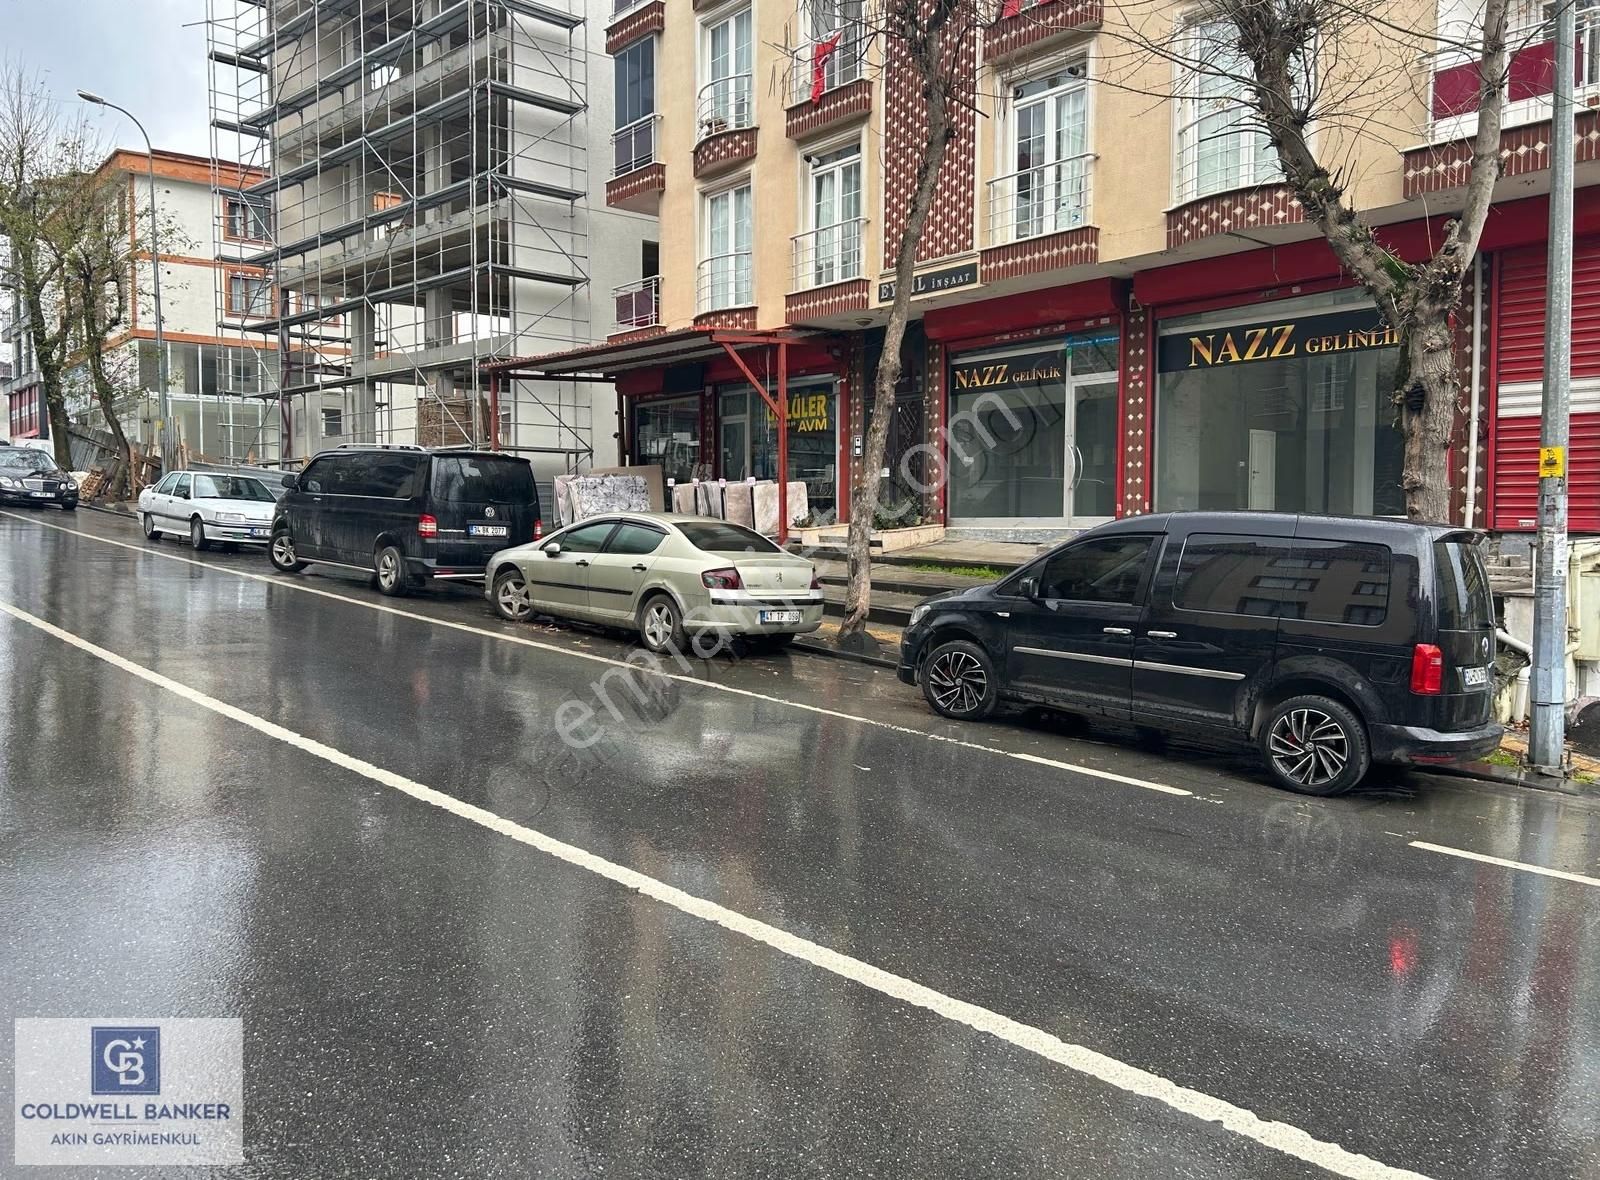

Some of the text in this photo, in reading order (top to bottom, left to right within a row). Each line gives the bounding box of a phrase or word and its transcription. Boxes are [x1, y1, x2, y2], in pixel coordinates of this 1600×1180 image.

[931, 273, 970, 289] İNŞAAT
[1189, 325, 1296, 367] NAZZ
[955, 364, 1061, 390] NAZZ GELİNLİK
[797, 418, 828, 433] AVM
